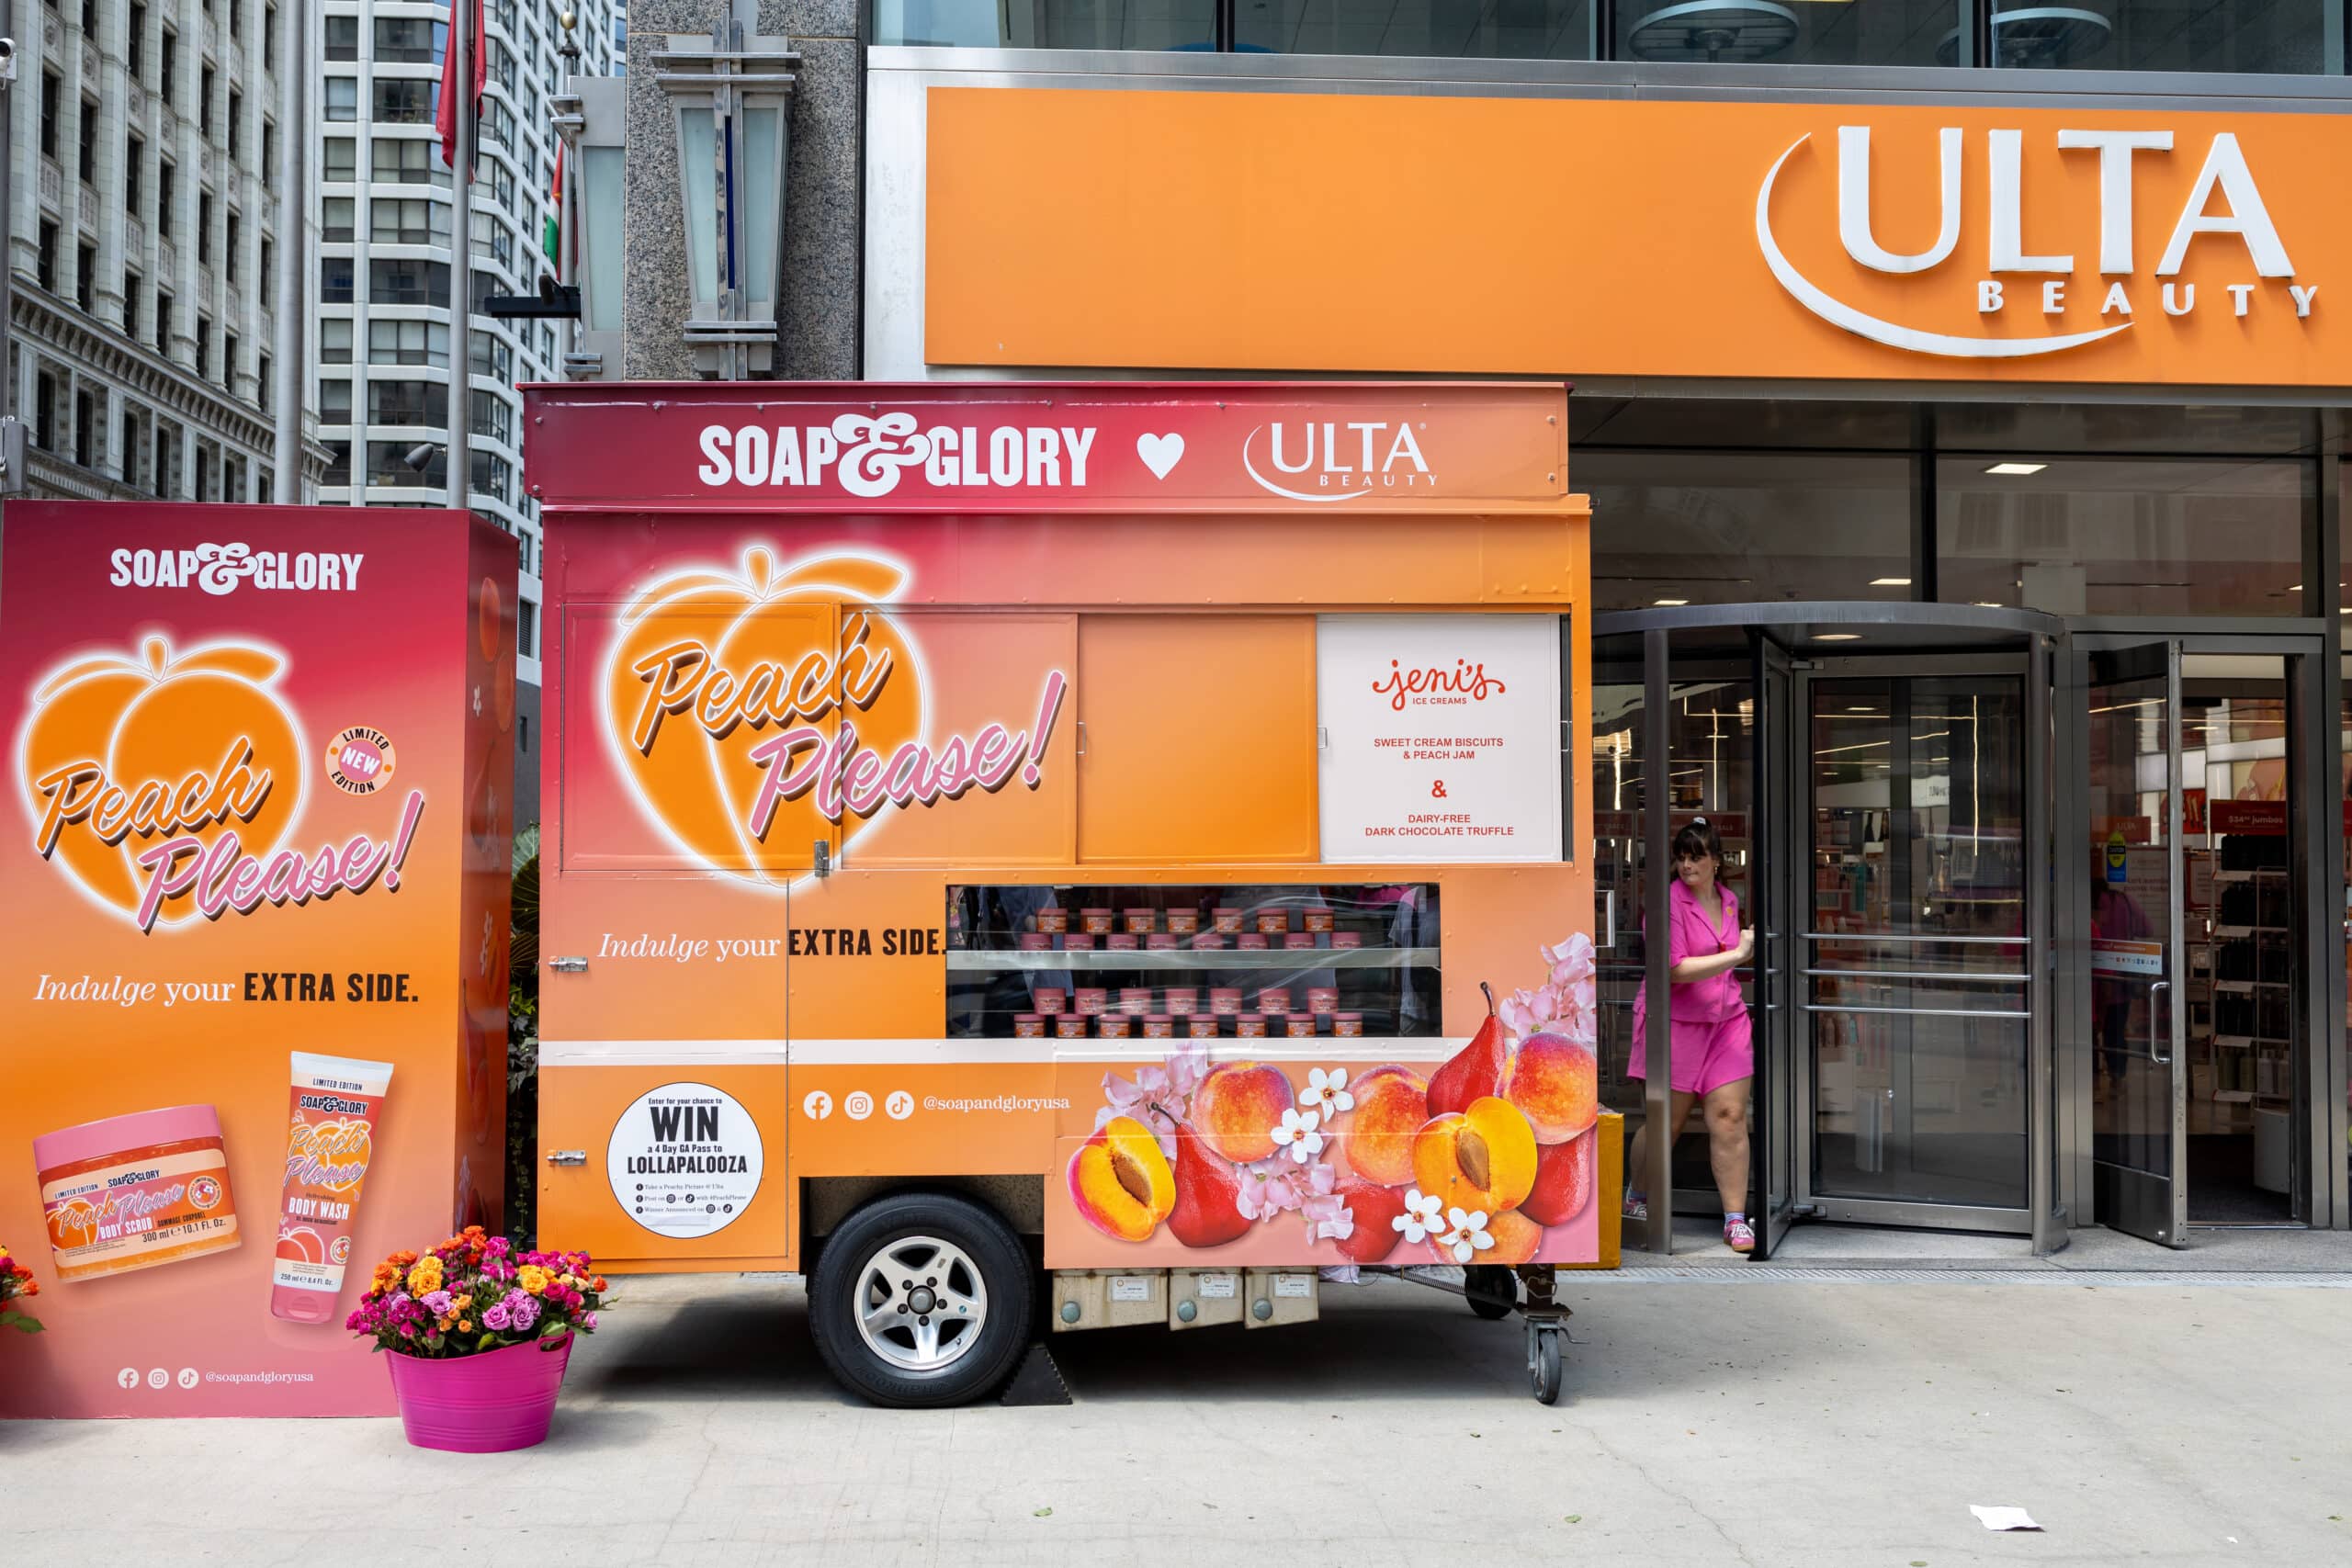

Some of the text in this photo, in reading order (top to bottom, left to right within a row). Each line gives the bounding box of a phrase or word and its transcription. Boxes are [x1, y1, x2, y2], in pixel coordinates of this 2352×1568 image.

[1838, 125, 2296, 277] ULTA
[1977, 279, 2318, 318] BEAUTY
[697, 412, 1097, 498] SOAP&GLORY
[1319, 474, 1438, 487] BEAUTY
[109, 542, 365, 596] SOAP&GLORY
[631, 610, 895, 758] Peach
[1372, 659, 1506, 711] jeni's
[342, 728, 390, 750] LIMITED
[1374, 738, 1504, 748] SWEET CREAM BISCUITS
[341, 747, 381, 775] NEW
[749, 670, 1067, 843] Please!
[1403, 750, 1476, 760] & PEACH JAM
[331, 771, 376, 794] EDITION
[1431, 780, 1447, 798] &
[35, 735, 275, 859] Peach
[1408, 814, 1471, 824] DAIRY-FREE
[2252, 815, 2284, 825] jumbos
[1365, 827, 1514, 836] DARK CHOCOLATE TRUFFLE
[136, 790, 426, 936] Please!
[599, 928, 947, 962] Indulge your EXTRA SIDE.
[33, 973, 420, 1007] Indulge your EXTRA SIDE.
[312, 1077, 363, 1092] LIMITED EDITION
[300, 1095, 368, 1115] SOAP&GLORY
[922, 1095, 1071, 1113] @soapandgloryusa
[650, 1106, 719, 1142] WIN
[288, 1122, 368, 1158] Peach
[654, 1145, 661, 1154] 4
[662, 1145, 677, 1155] Day
[679, 1145, 690, 1153] GA
[692, 1145, 711, 1153] Pass
[714, 1145, 723, 1153] to
[284, 1156, 366, 1187] Please
[628, 1156, 748, 1174] LOLLAPALOOZA
[107, 1169, 160, 1189] SOAP&GLORY
[54, 1183, 98, 1200] LIMITED EDITION
[58, 1190, 119, 1238] Peach
[110, 1182, 187, 1225] Please
[288, 1197, 317, 1216] BODY
[320, 1200, 350, 1221] WASH
[99, 1217, 153, 1240] BODY SCRUB
[141, 1232, 157, 1243] 300
[159, 1229, 170, 1239] ml
[183, 1225, 199, 1235] 10.1
[201, 1222, 212, 1232] Fl.
[213, 1218, 226, 1228] Oz.
[280, 1273, 291, 1281] 250
[292, 1274, 300, 1282] ml
[205, 1369, 314, 1387] @soapandgloryusa
